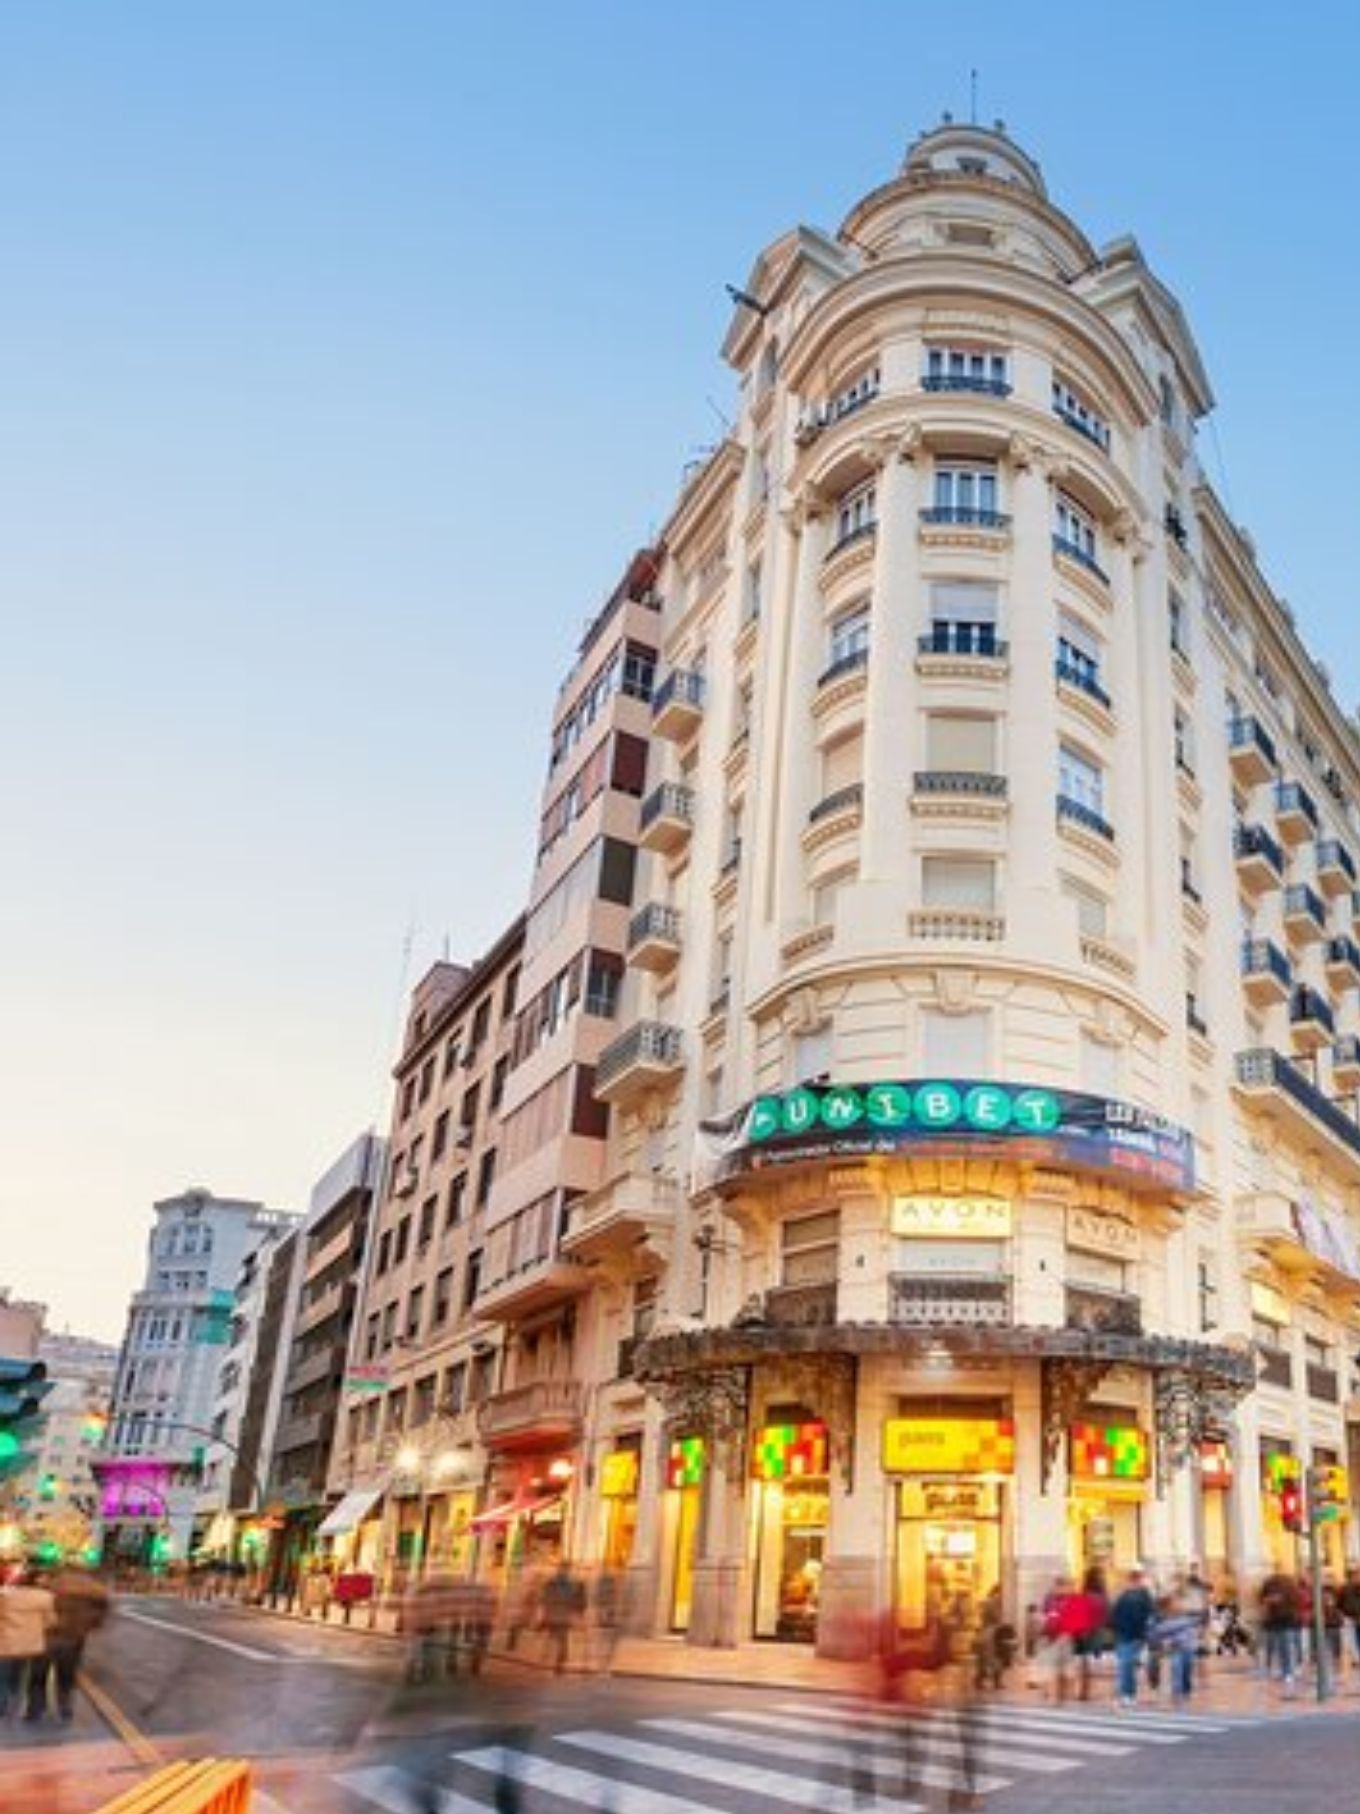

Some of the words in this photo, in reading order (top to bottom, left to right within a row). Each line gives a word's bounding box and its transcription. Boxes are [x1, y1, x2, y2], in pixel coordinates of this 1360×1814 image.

[788, 1093, 1047, 1126] UNIBET
[902, 1201, 1006, 1218] AVON
[1074, 1216, 1138, 1244] AVON
